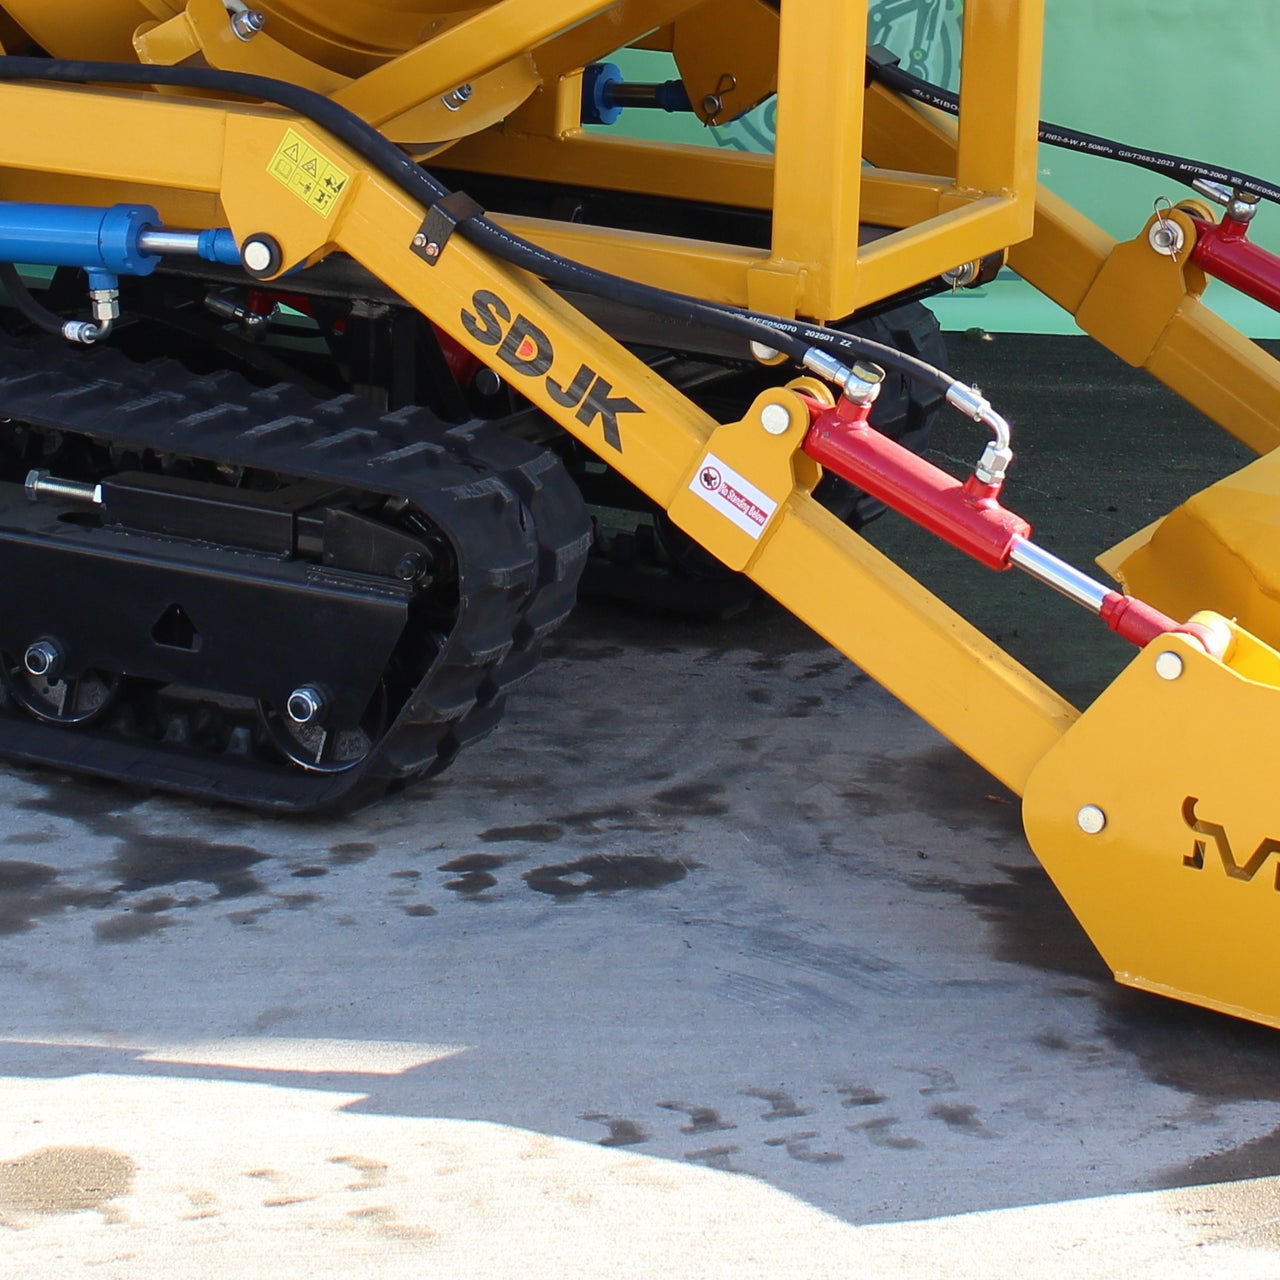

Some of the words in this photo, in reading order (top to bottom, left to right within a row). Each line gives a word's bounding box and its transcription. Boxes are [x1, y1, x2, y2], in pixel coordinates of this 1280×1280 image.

[804, 329, 834, 342] 202501
[460, 289, 646, 454] SDJK
[717, 482, 730, 497] No
[724, 489, 752, 514] Standing
[746, 504, 768, 524] Below
